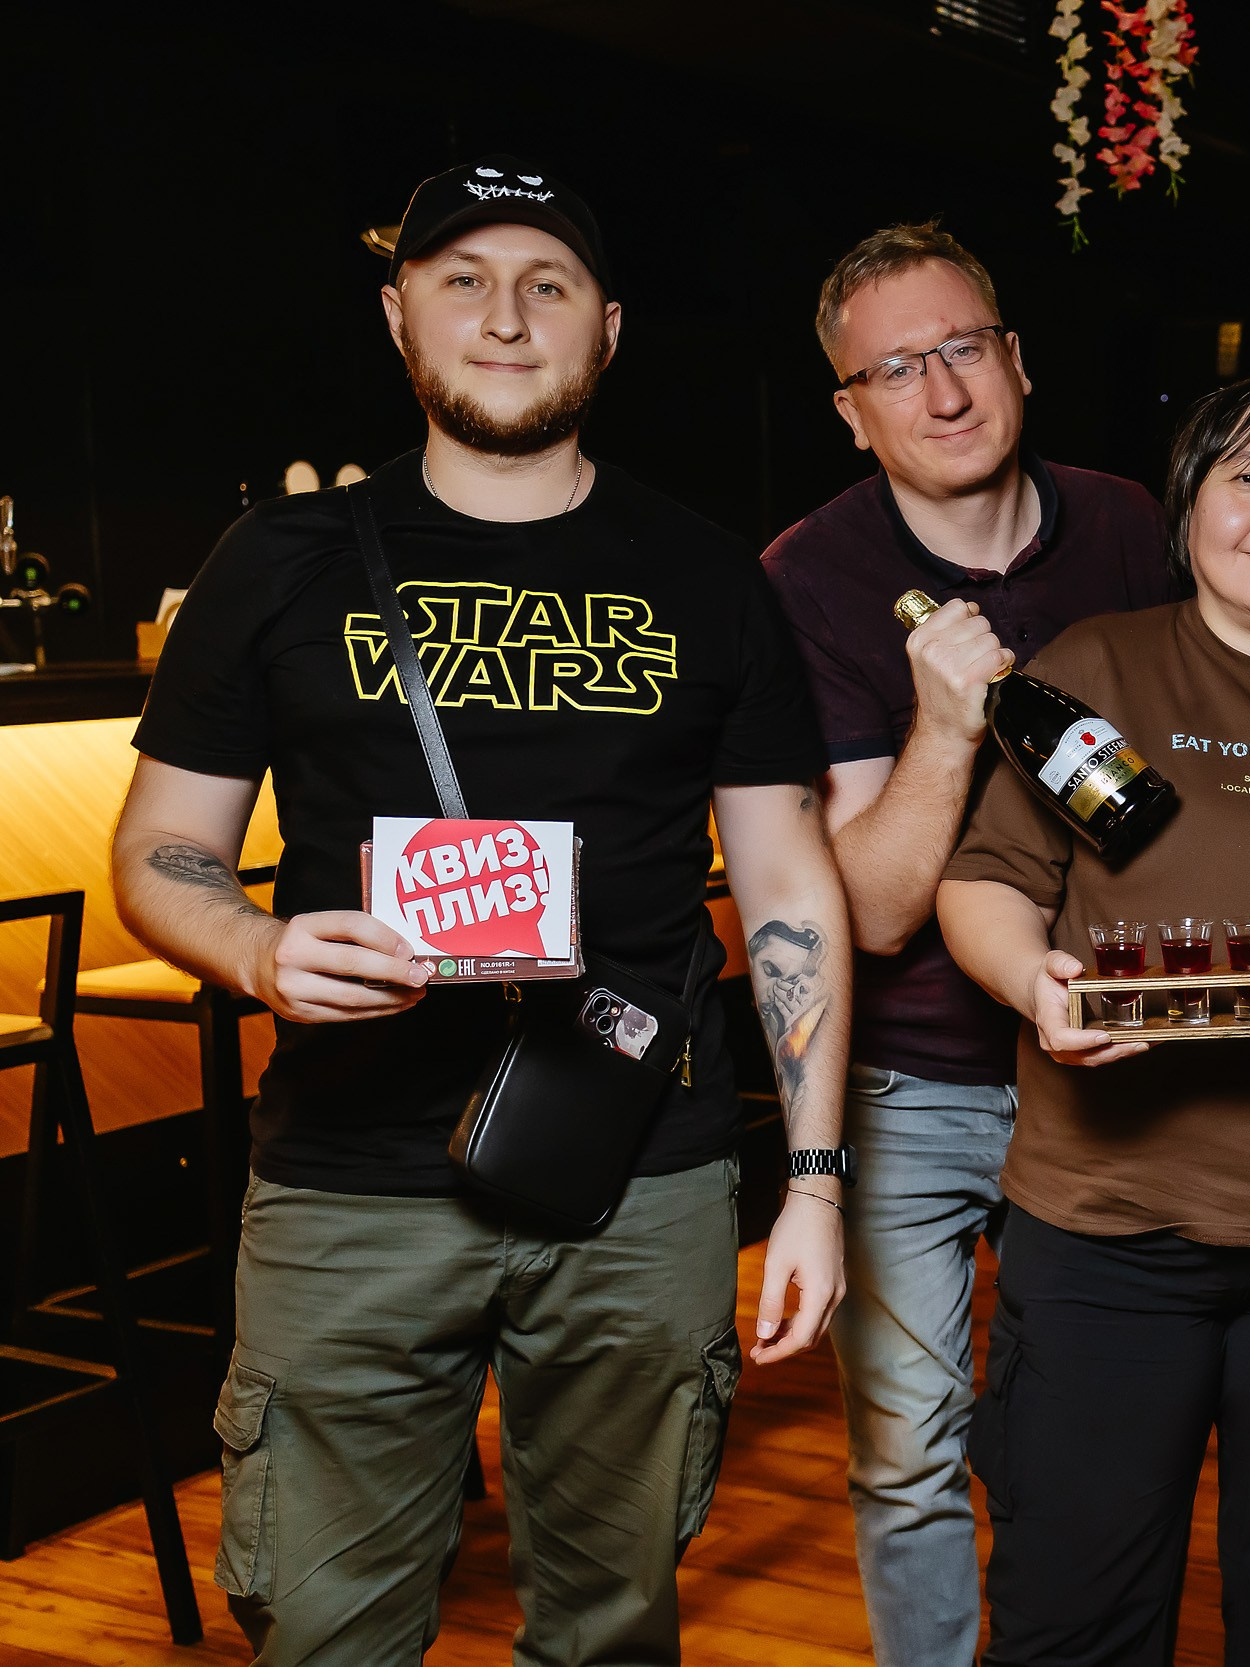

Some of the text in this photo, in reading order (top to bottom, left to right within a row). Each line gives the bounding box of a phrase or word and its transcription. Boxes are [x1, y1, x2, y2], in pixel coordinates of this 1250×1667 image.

[344, 581, 676, 657] STAR
[344, 635, 678, 715] WARS
[1067, 757, 1099, 791] SANTO
[1171, 733, 1212, 753] EAT
[401, 867, 551, 937] ПЛИЗ!
